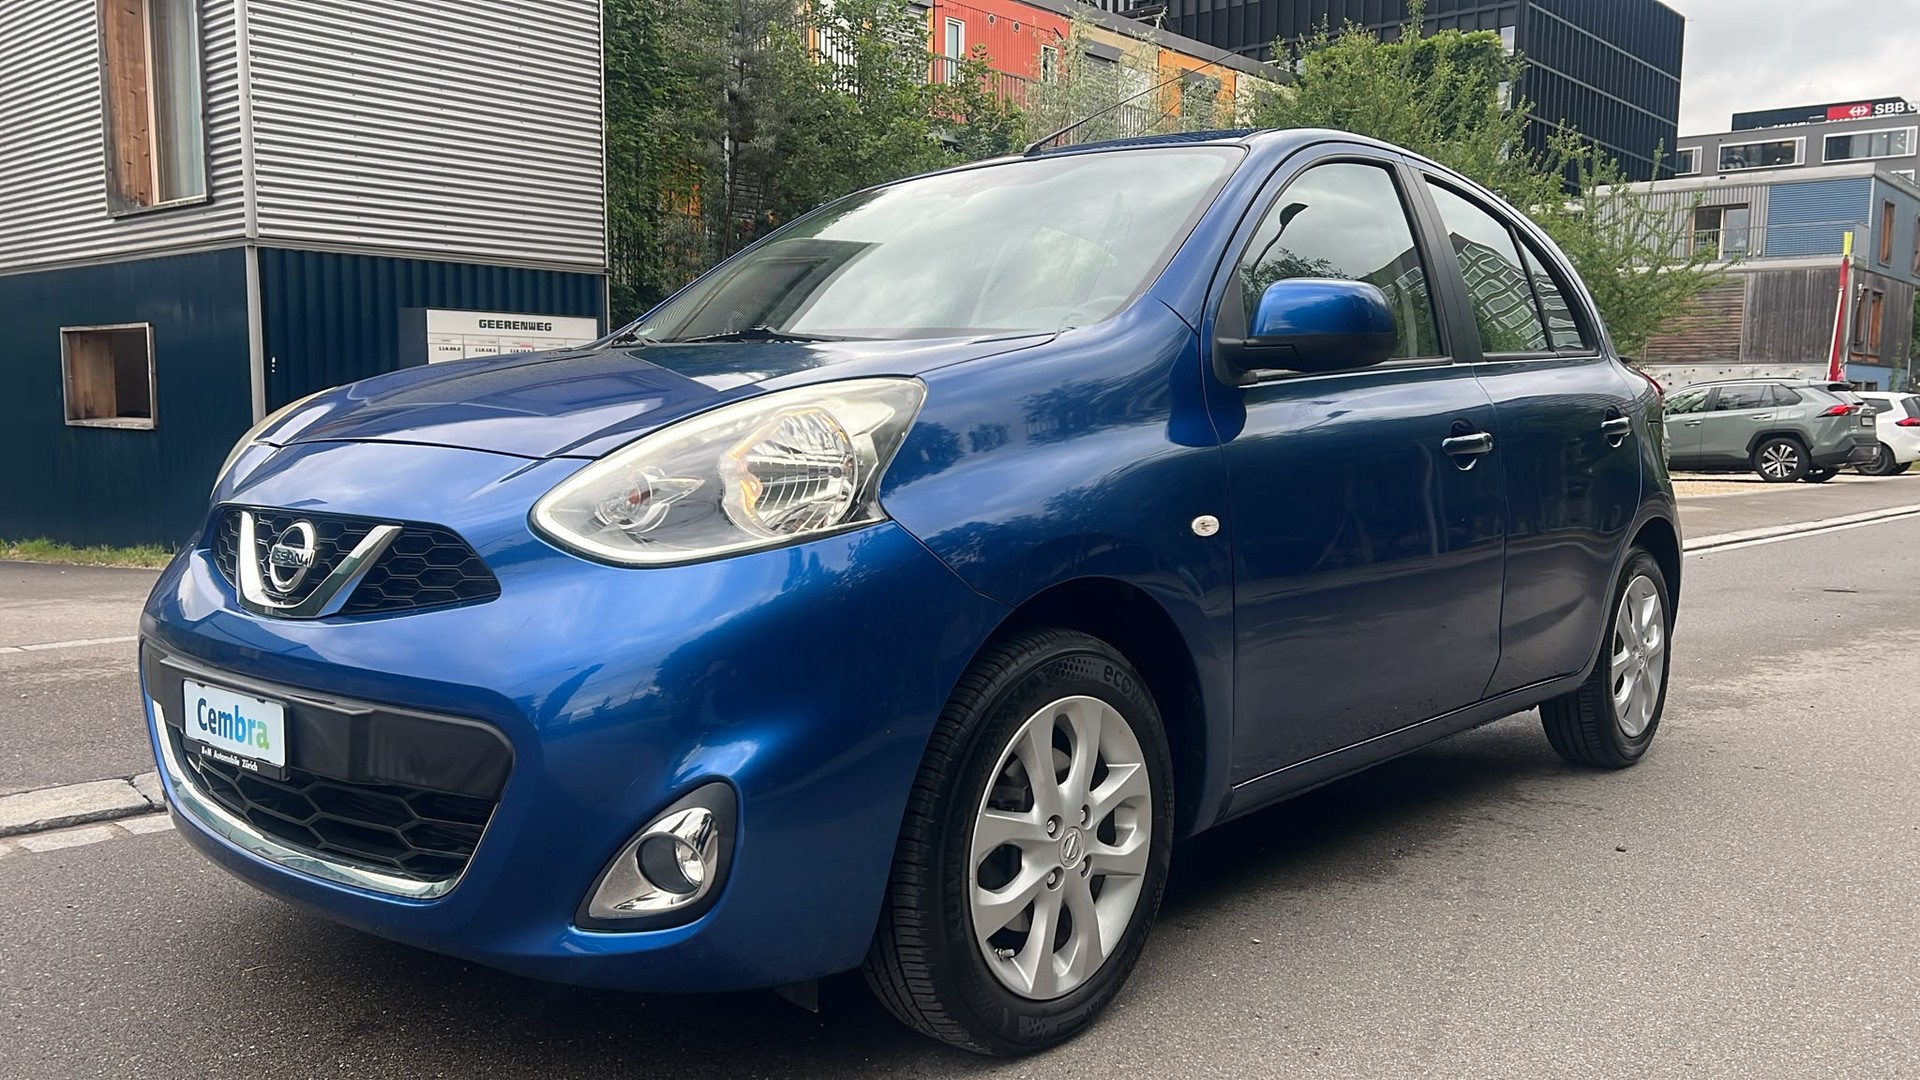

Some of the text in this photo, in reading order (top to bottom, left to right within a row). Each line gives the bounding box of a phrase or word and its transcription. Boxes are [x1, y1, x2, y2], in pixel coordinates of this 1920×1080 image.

[1874, 101, 1905, 114] SBB
[478, 319, 552, 332] GEERENWEG
[197, 697, 270, 751] Cembra
